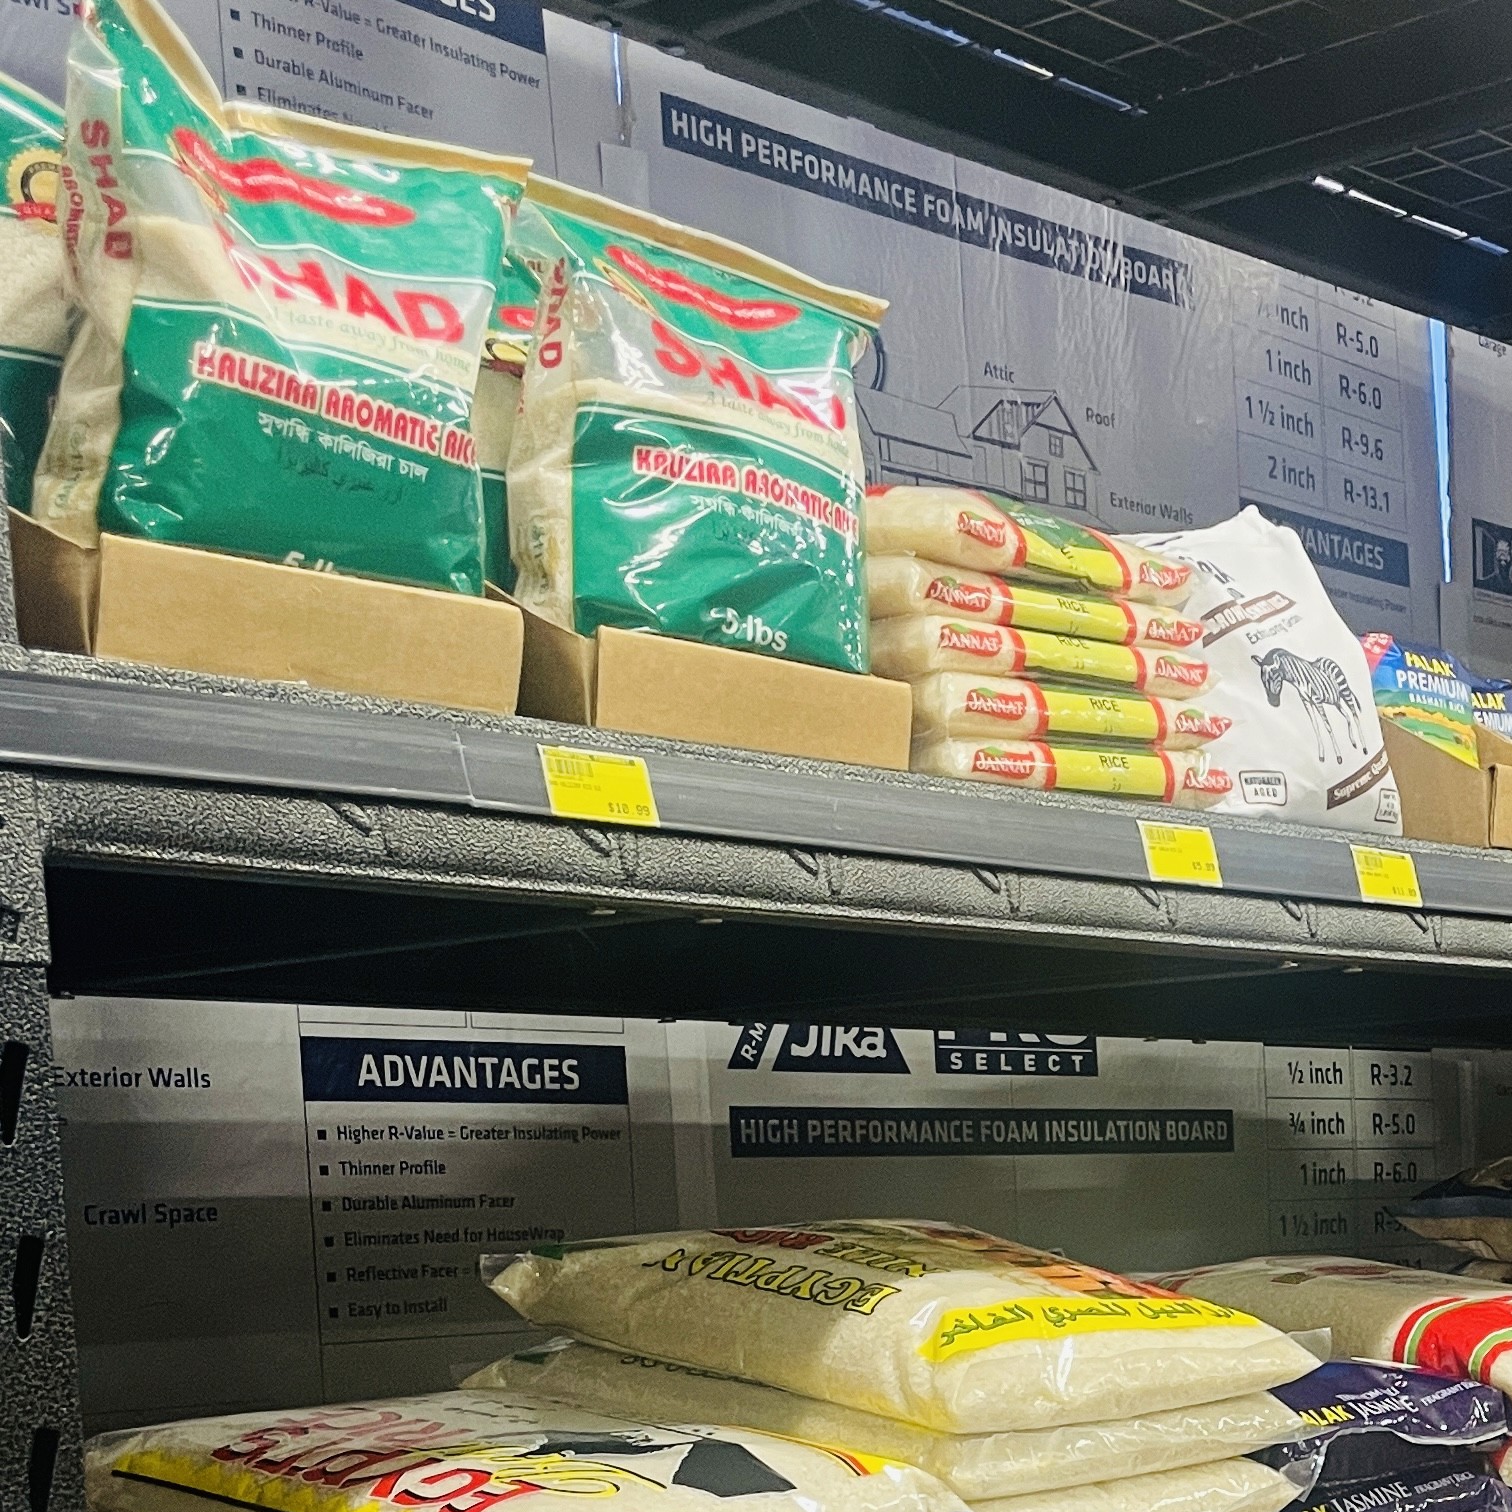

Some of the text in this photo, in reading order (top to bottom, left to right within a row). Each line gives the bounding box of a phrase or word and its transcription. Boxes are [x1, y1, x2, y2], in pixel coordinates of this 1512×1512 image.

[250, 11, 365, 62] Thinner Profile
[429, 35, 541, 90] Insulating Power
[254, 49, 434, 121] Durable Aluminum Facer
[670, 109, 985, 236] HIGH PERFORMANCE FOAM
[80, 119, 134, 260] SHAD
[1336, 322, 1380, 359] R-5.0
[983, 360, 1016, 385] Attic
[1276, 351, 1383, 411] inch R-6.0
[197, 350, 439, 453] KALIZIRA AROMATIC
[1085, 406, 1117, 429] Roof
[1280, 409, 1385, 461] inch R-9.6
[1267, 455, 1392, 514] 2 inch R-13.1
[1110, 491, 1195, 527] Exterior Walls
[929, 579, 991, 611] JANNAT
[1058, 598, 1091, 615] RICE
[1405, 651, 1457, 678] FALAK
[1396, 670, 1469, 702] PREMIUM
[1088, 697, 1121, 713] RICE
[1471, 692, 1505, 710] ALAK
[1099, 753, 1130, 769] RICE
[357, 1053, 581, 1091] ADVANTAGES
[950, 1052, 1086, 1073] SELECT
[1310, 1061, 1413, 1086] inch R-3.2
[52, 1065, 211, 1090] Exterior Walls
[337, 1125, 622, 1146] Higher R-Value Greater Insulating Power
[740, 1118, 1229, 1145] HIGH PERFORMANCE FOAM INSULATION BOARD
[1311, 1111, 1416, 1136] inch R-5.0
[339, 1159, 447, 1177] Thinner Profile
[1374, 1161, 1418, 1184] R-6.0
[84, 1202, 219, 1227] Crawl Space
[341, 1194, 516, 1211] Durable Aluminum Facer
[344, 1226, 566, 1248] Eliminates Need for HouseWrap
[347, 1264, 460, 1284] Reflective Facer
[348, 1298, 449, 1321] Easy to Install
